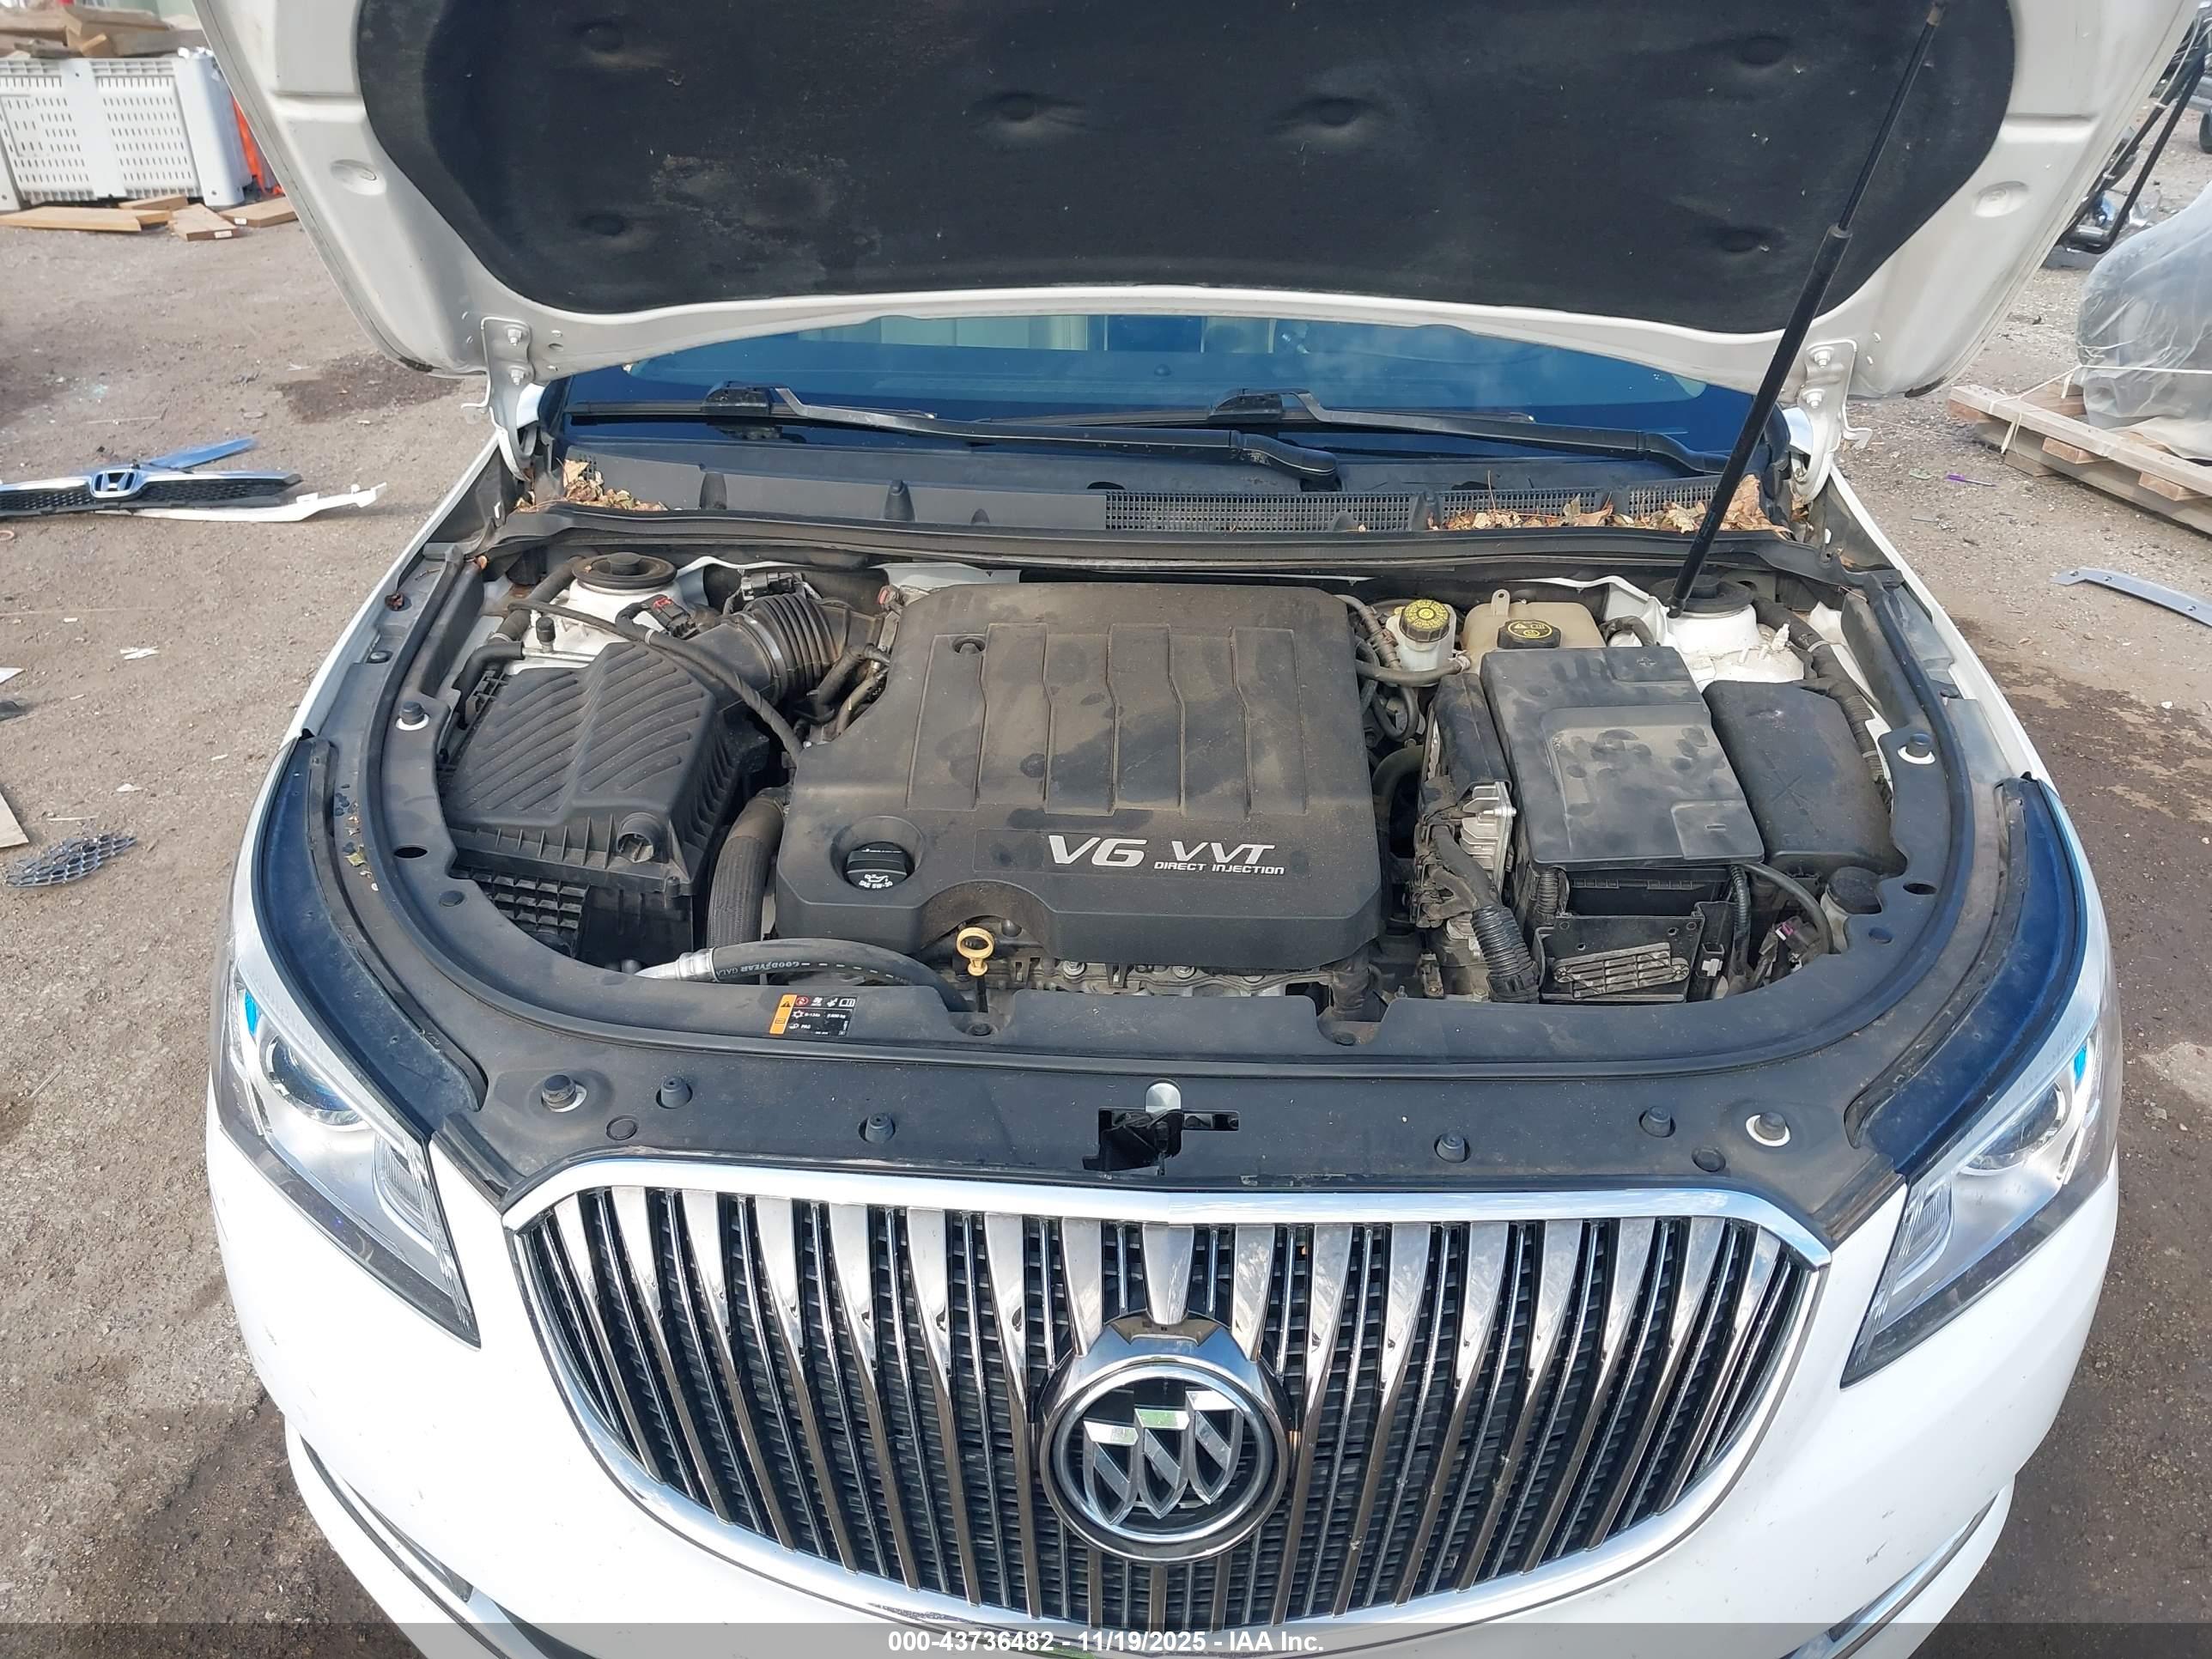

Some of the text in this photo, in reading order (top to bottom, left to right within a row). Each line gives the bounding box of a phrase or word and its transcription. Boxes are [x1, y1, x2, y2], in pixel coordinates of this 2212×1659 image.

[1048, 836, 1275, 867] V6 VVT
[1153, 861, 1285, 875] DIRECT INJECTION
[740, 961, 799, 973] GOODYEAR
